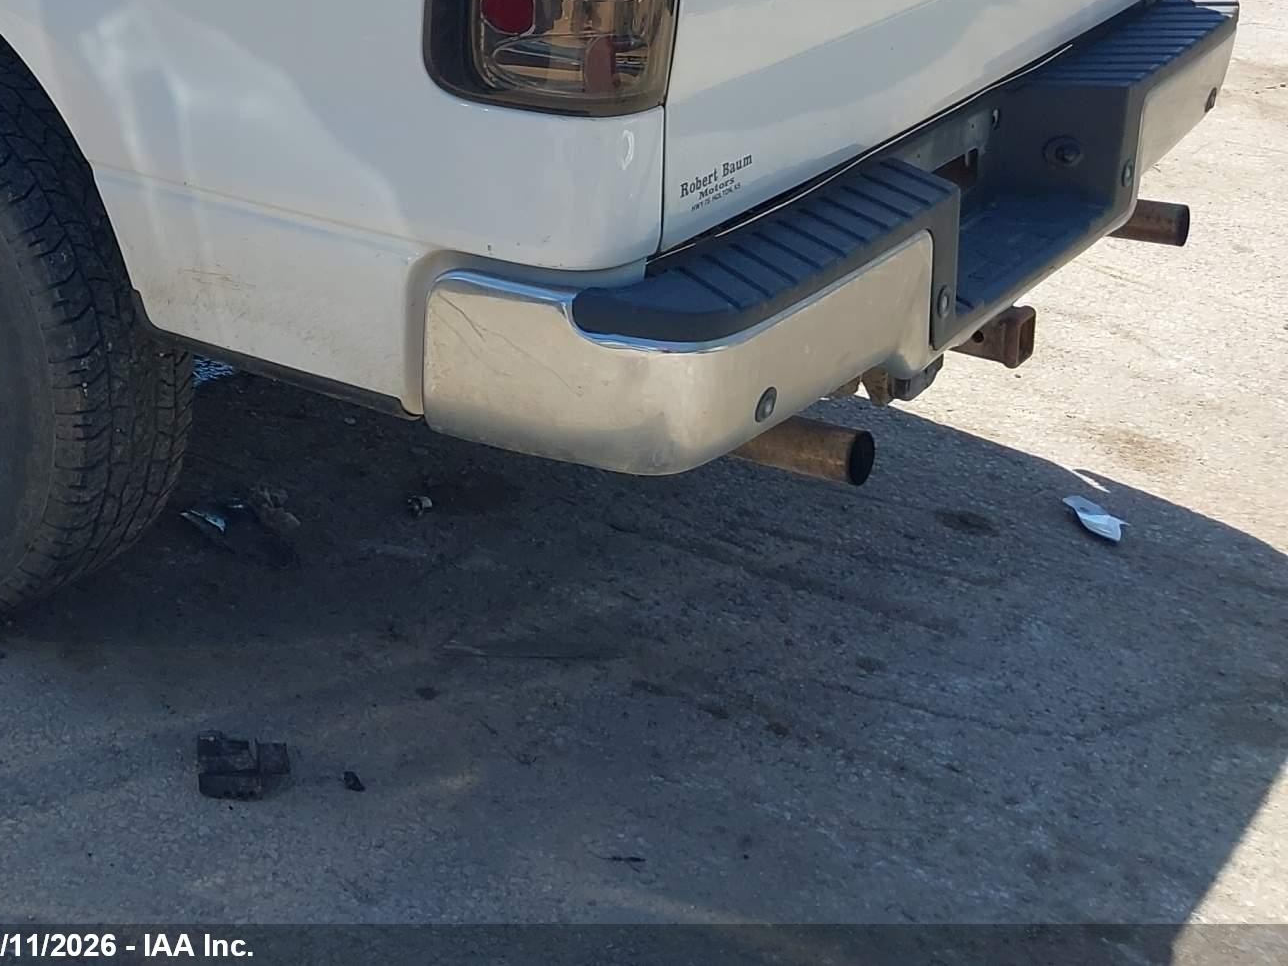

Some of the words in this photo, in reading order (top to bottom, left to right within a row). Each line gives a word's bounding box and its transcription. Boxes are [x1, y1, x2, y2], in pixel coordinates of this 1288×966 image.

[680, 168, 718, 199] Robert
[722, 154, 753, 177] Baum
[698, 177, 735, 200] Motors
